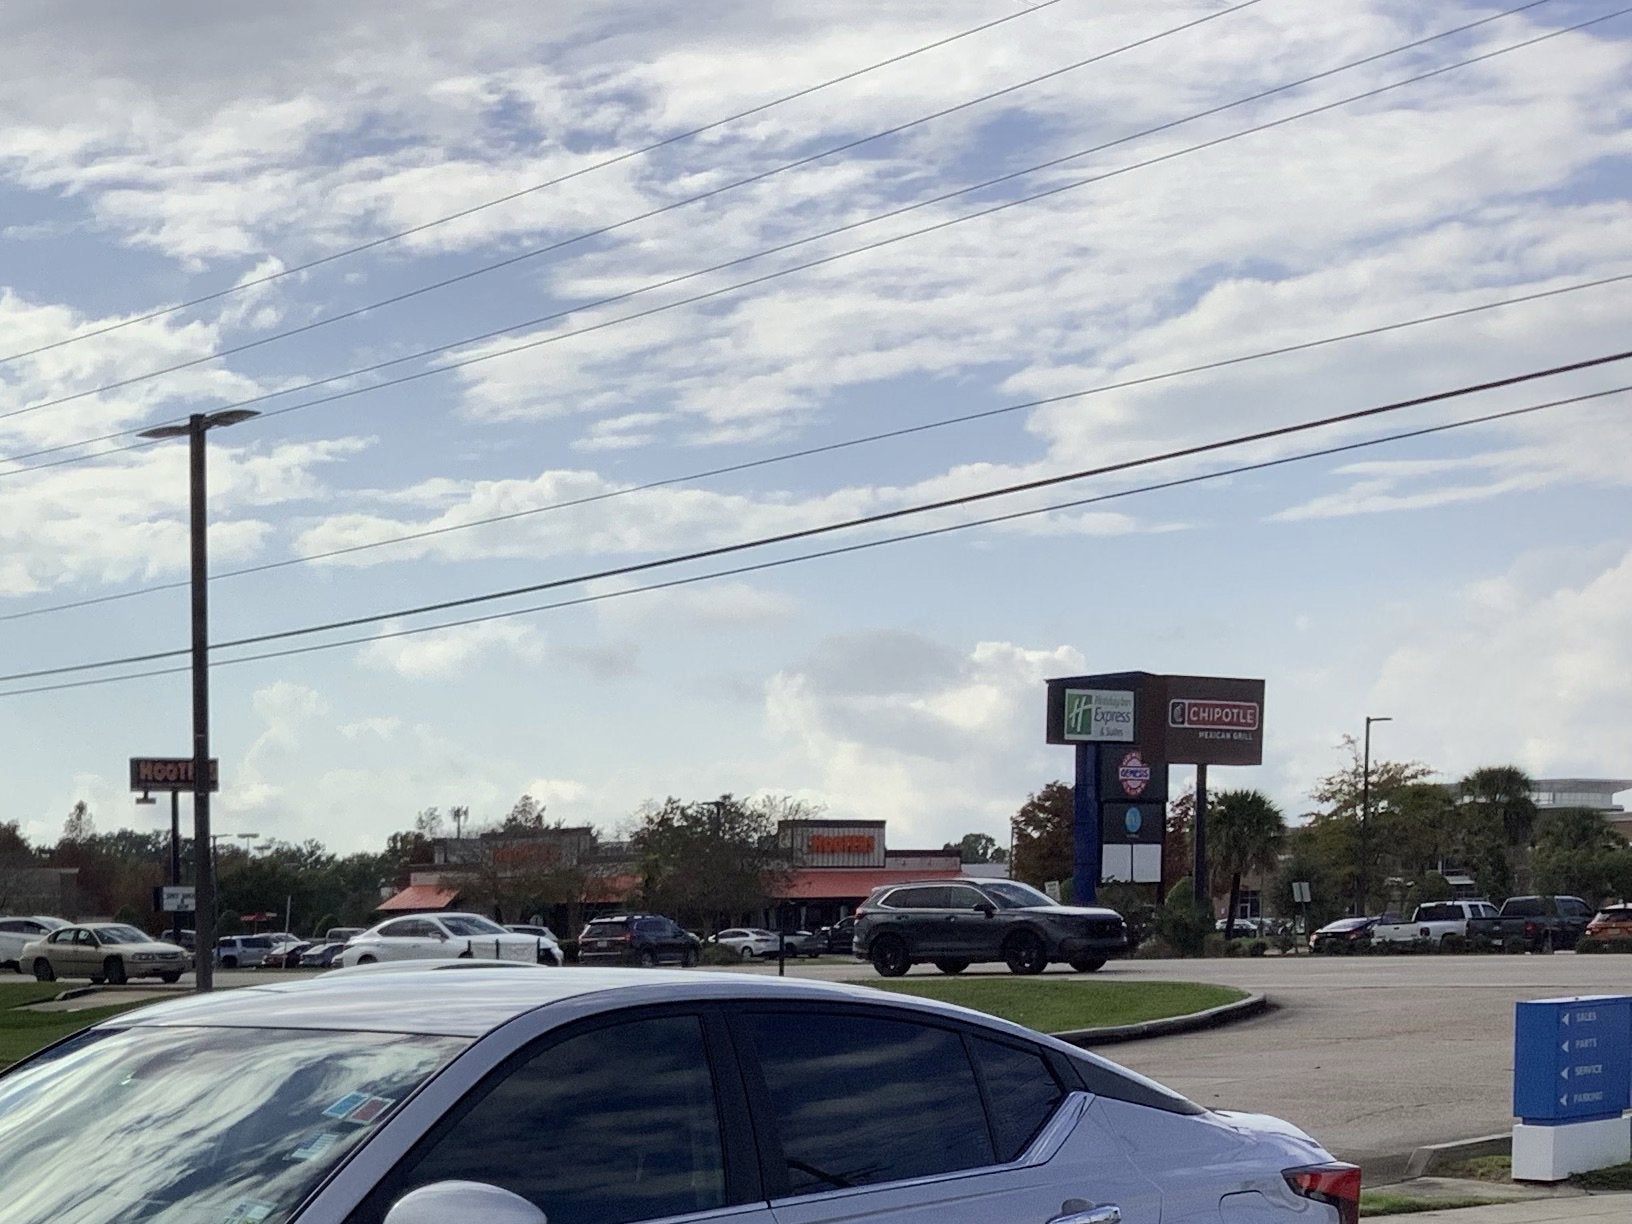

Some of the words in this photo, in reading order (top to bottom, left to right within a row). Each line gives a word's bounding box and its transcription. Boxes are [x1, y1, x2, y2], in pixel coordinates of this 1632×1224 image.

[1094, 706, 1132, 726] Express
[1189, 706, 1255, 723] CHIPOTLE
[1199, 731, 1231, 739] MEXICAN
[1574, 1065, 1603, 1076] SERVICE
